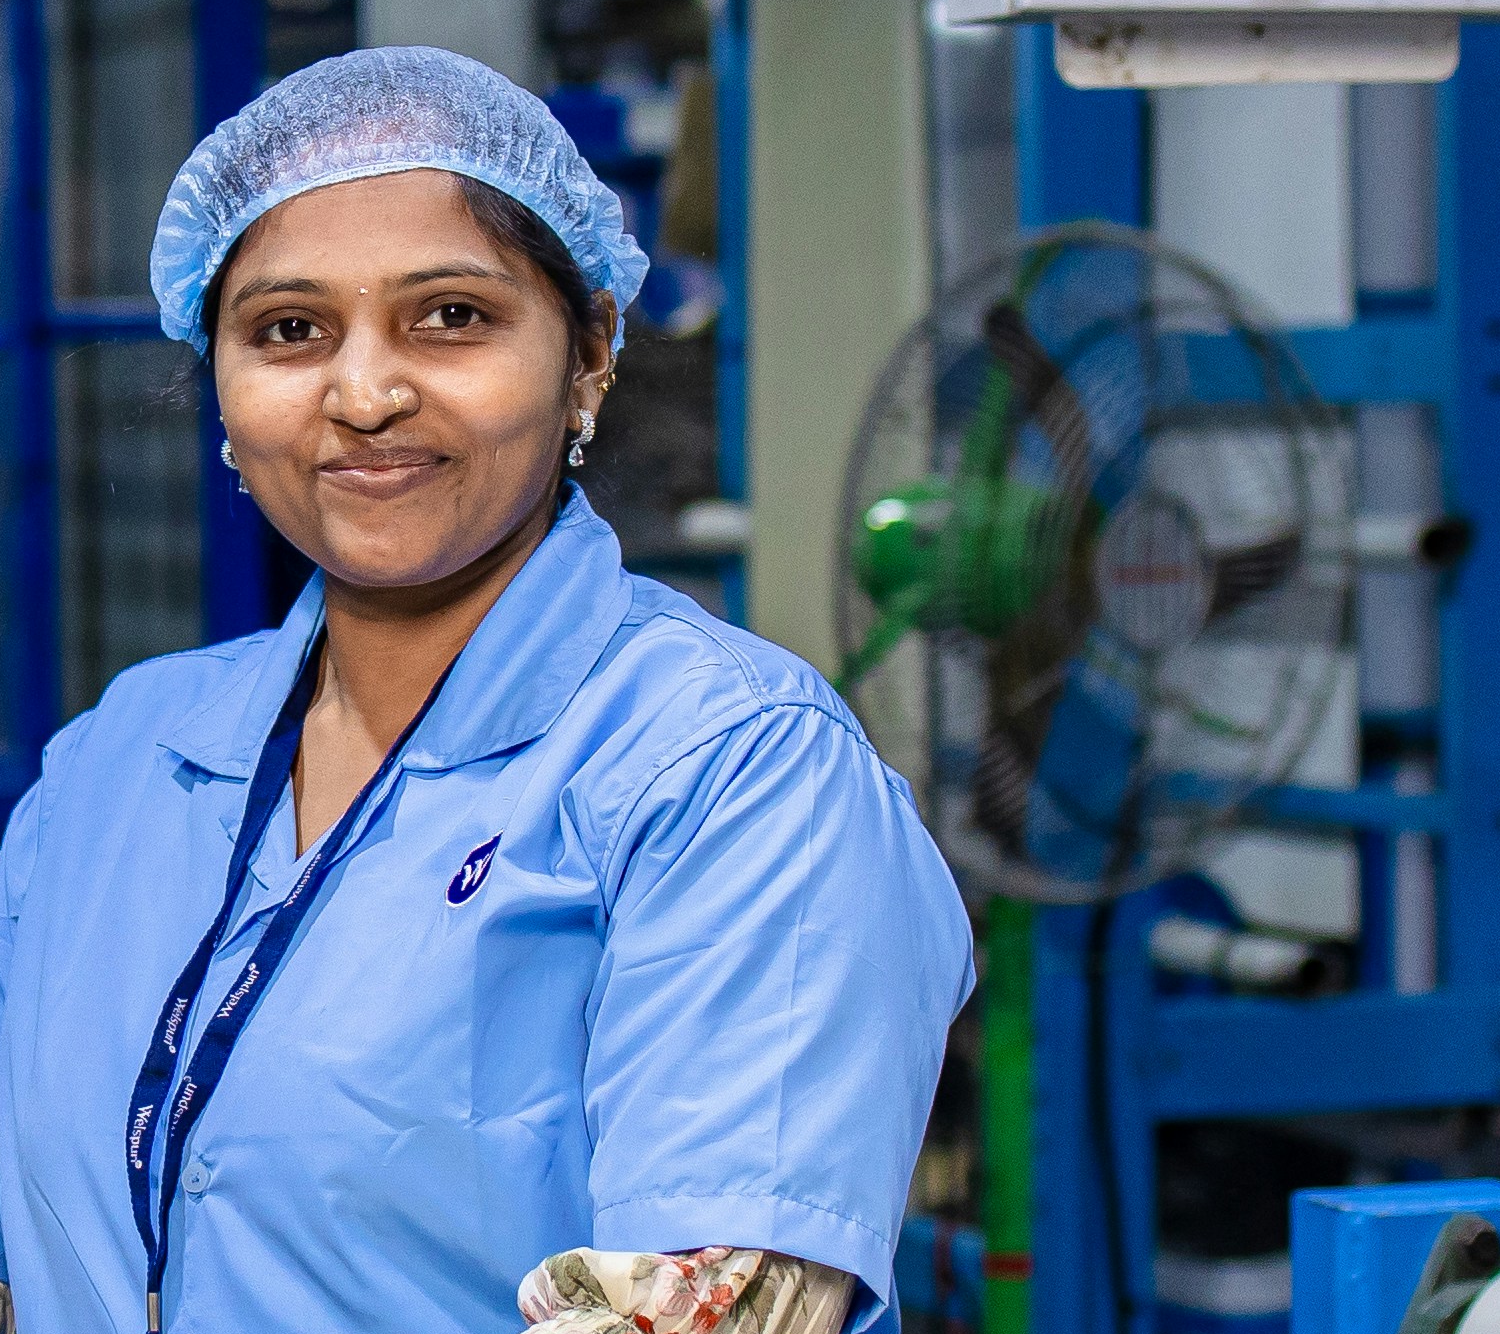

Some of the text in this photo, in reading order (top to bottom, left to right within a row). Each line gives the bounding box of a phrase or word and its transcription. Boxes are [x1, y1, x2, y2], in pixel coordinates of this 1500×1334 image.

[283, 853, 321, 908] Welspun
[217, 967, 259, 1018] Welspun
[163, 997, 188, 1046] Welspun
[129, 1104, 154, 1163] Welspun
[171, 1082, 198, 1137] elspun
